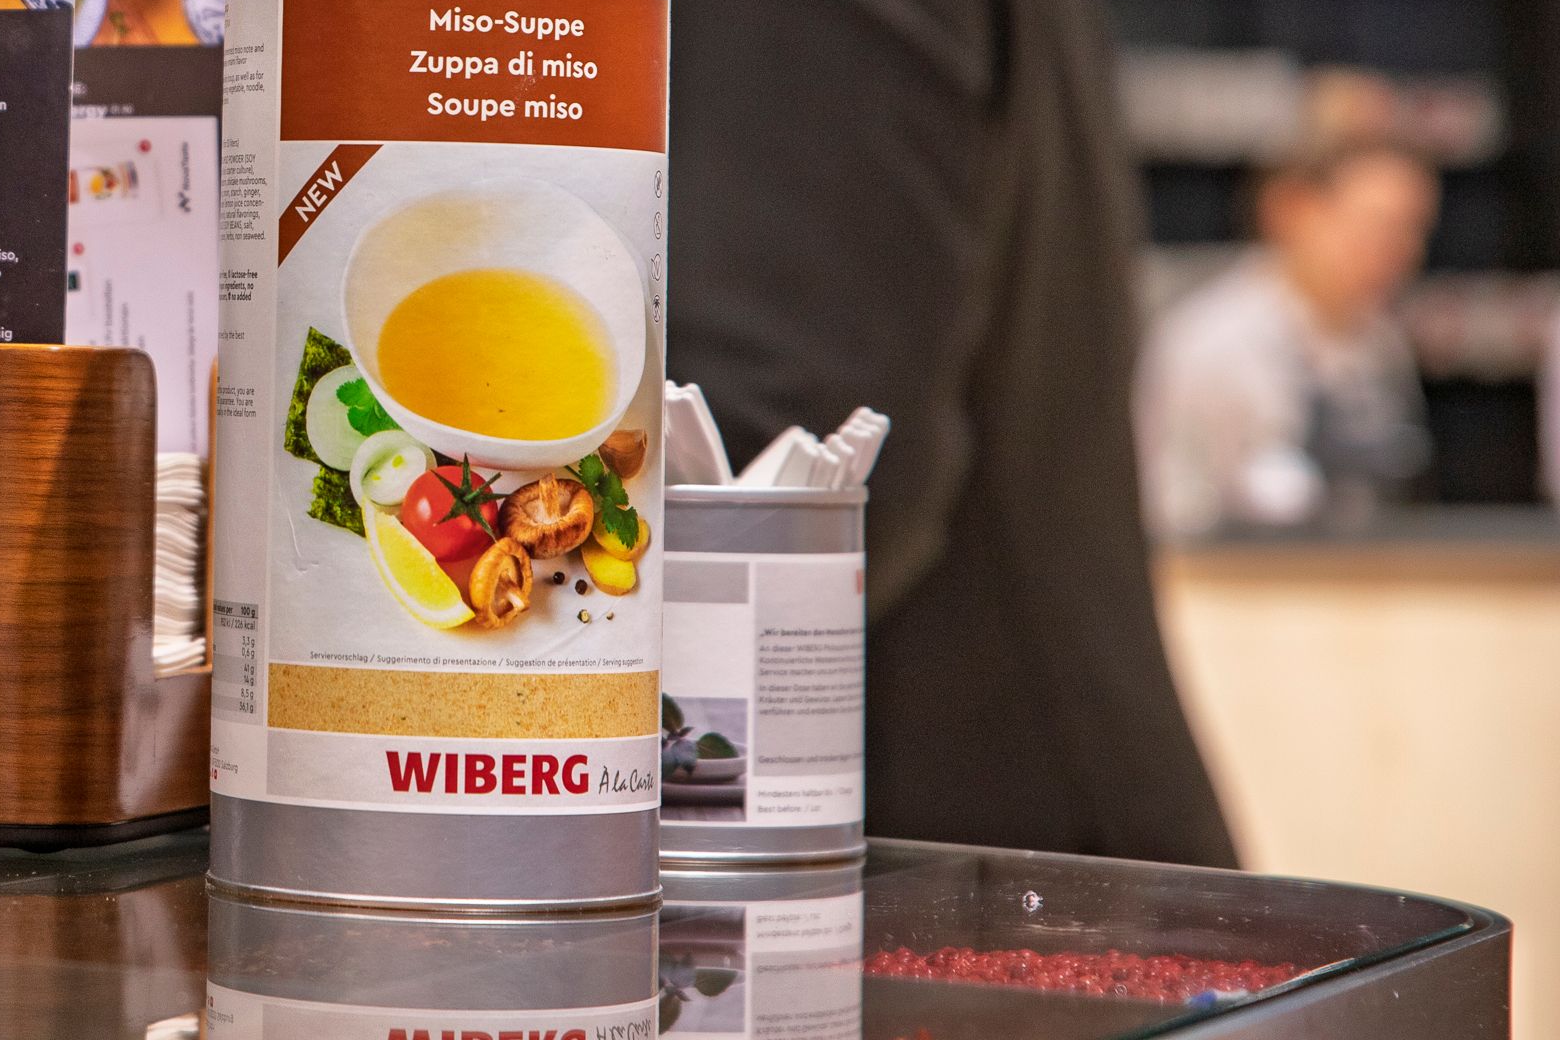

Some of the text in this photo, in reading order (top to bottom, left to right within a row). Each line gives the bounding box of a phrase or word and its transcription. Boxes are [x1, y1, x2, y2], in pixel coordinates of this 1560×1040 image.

[429, 7, 585, 41] Miso-Suppe
[409, 50, 598, 80] Zuppa di miso
[427, 93, 583, 121] Soupe miso
[294, 160, 346, 223] NEW
[240, 606, 250, 615] 100
[310, 650, 368, 663] Serviervorschlag
[376, 654, 431, 666] Suggerimento
[432, 656, 441, 666] di
[442, 657, 497, 668] presentazione
[505, 657, 546, 668] Suggestion
[547, 657, 557, 667] de
[385, 750, 589, 796] WIBERG
